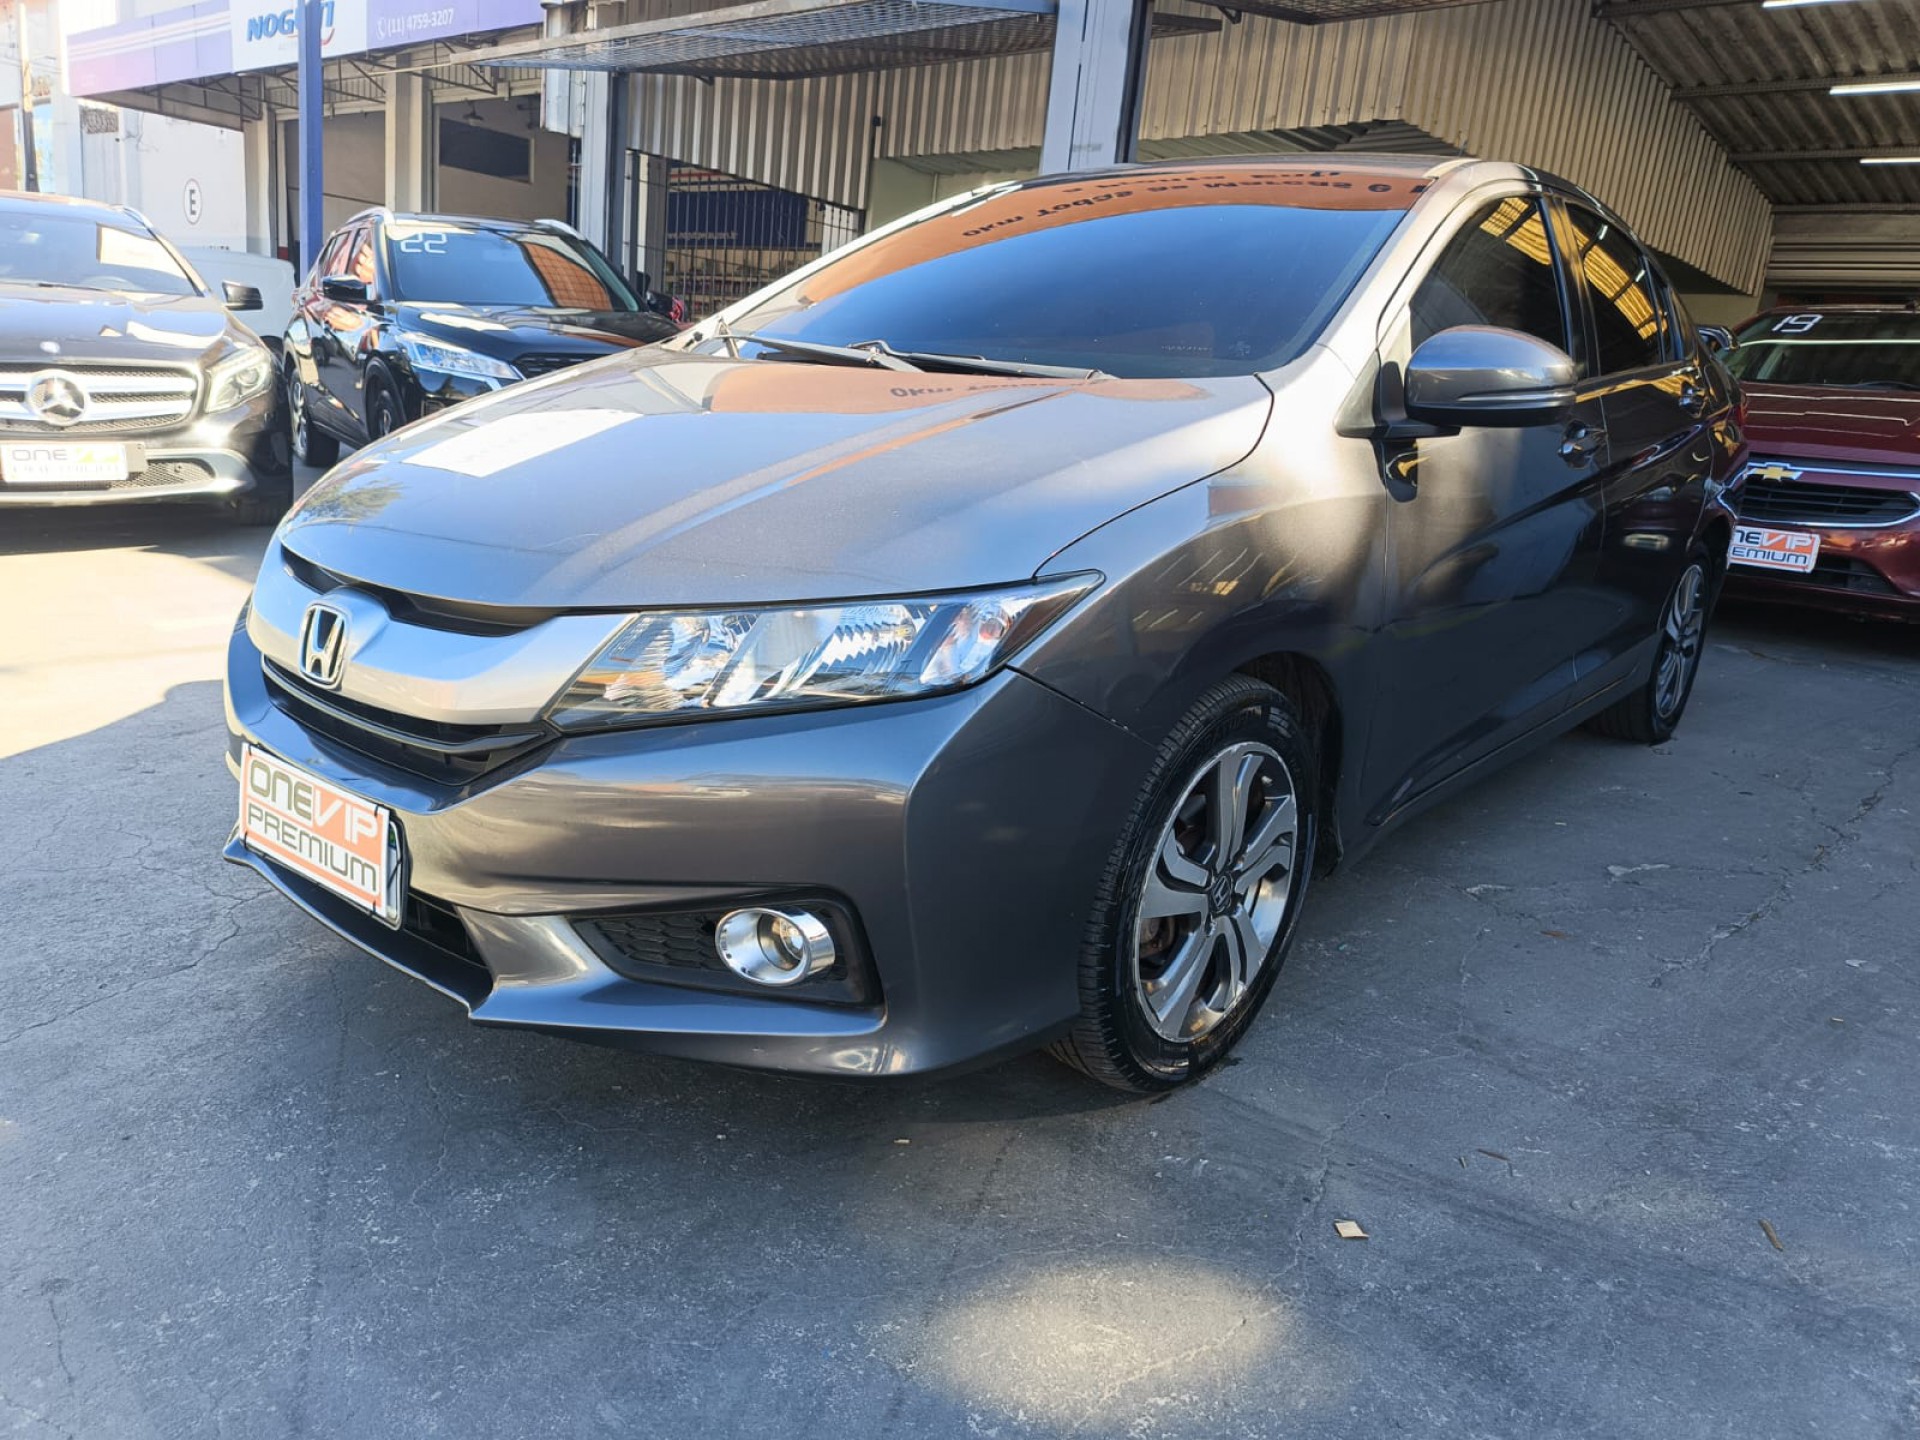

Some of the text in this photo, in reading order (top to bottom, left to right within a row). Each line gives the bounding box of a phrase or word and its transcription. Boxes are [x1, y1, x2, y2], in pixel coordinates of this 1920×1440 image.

[388, 8, 454, 37] (11) 4759-3207
[189, 189, 196, 215] E
[401, 232, 447, 254] 22
[1771, 314, 1824, 332] 19
[1732, 546, 1807, 564] EMIUM
[248, 802, 377, 892] PREMIUM
